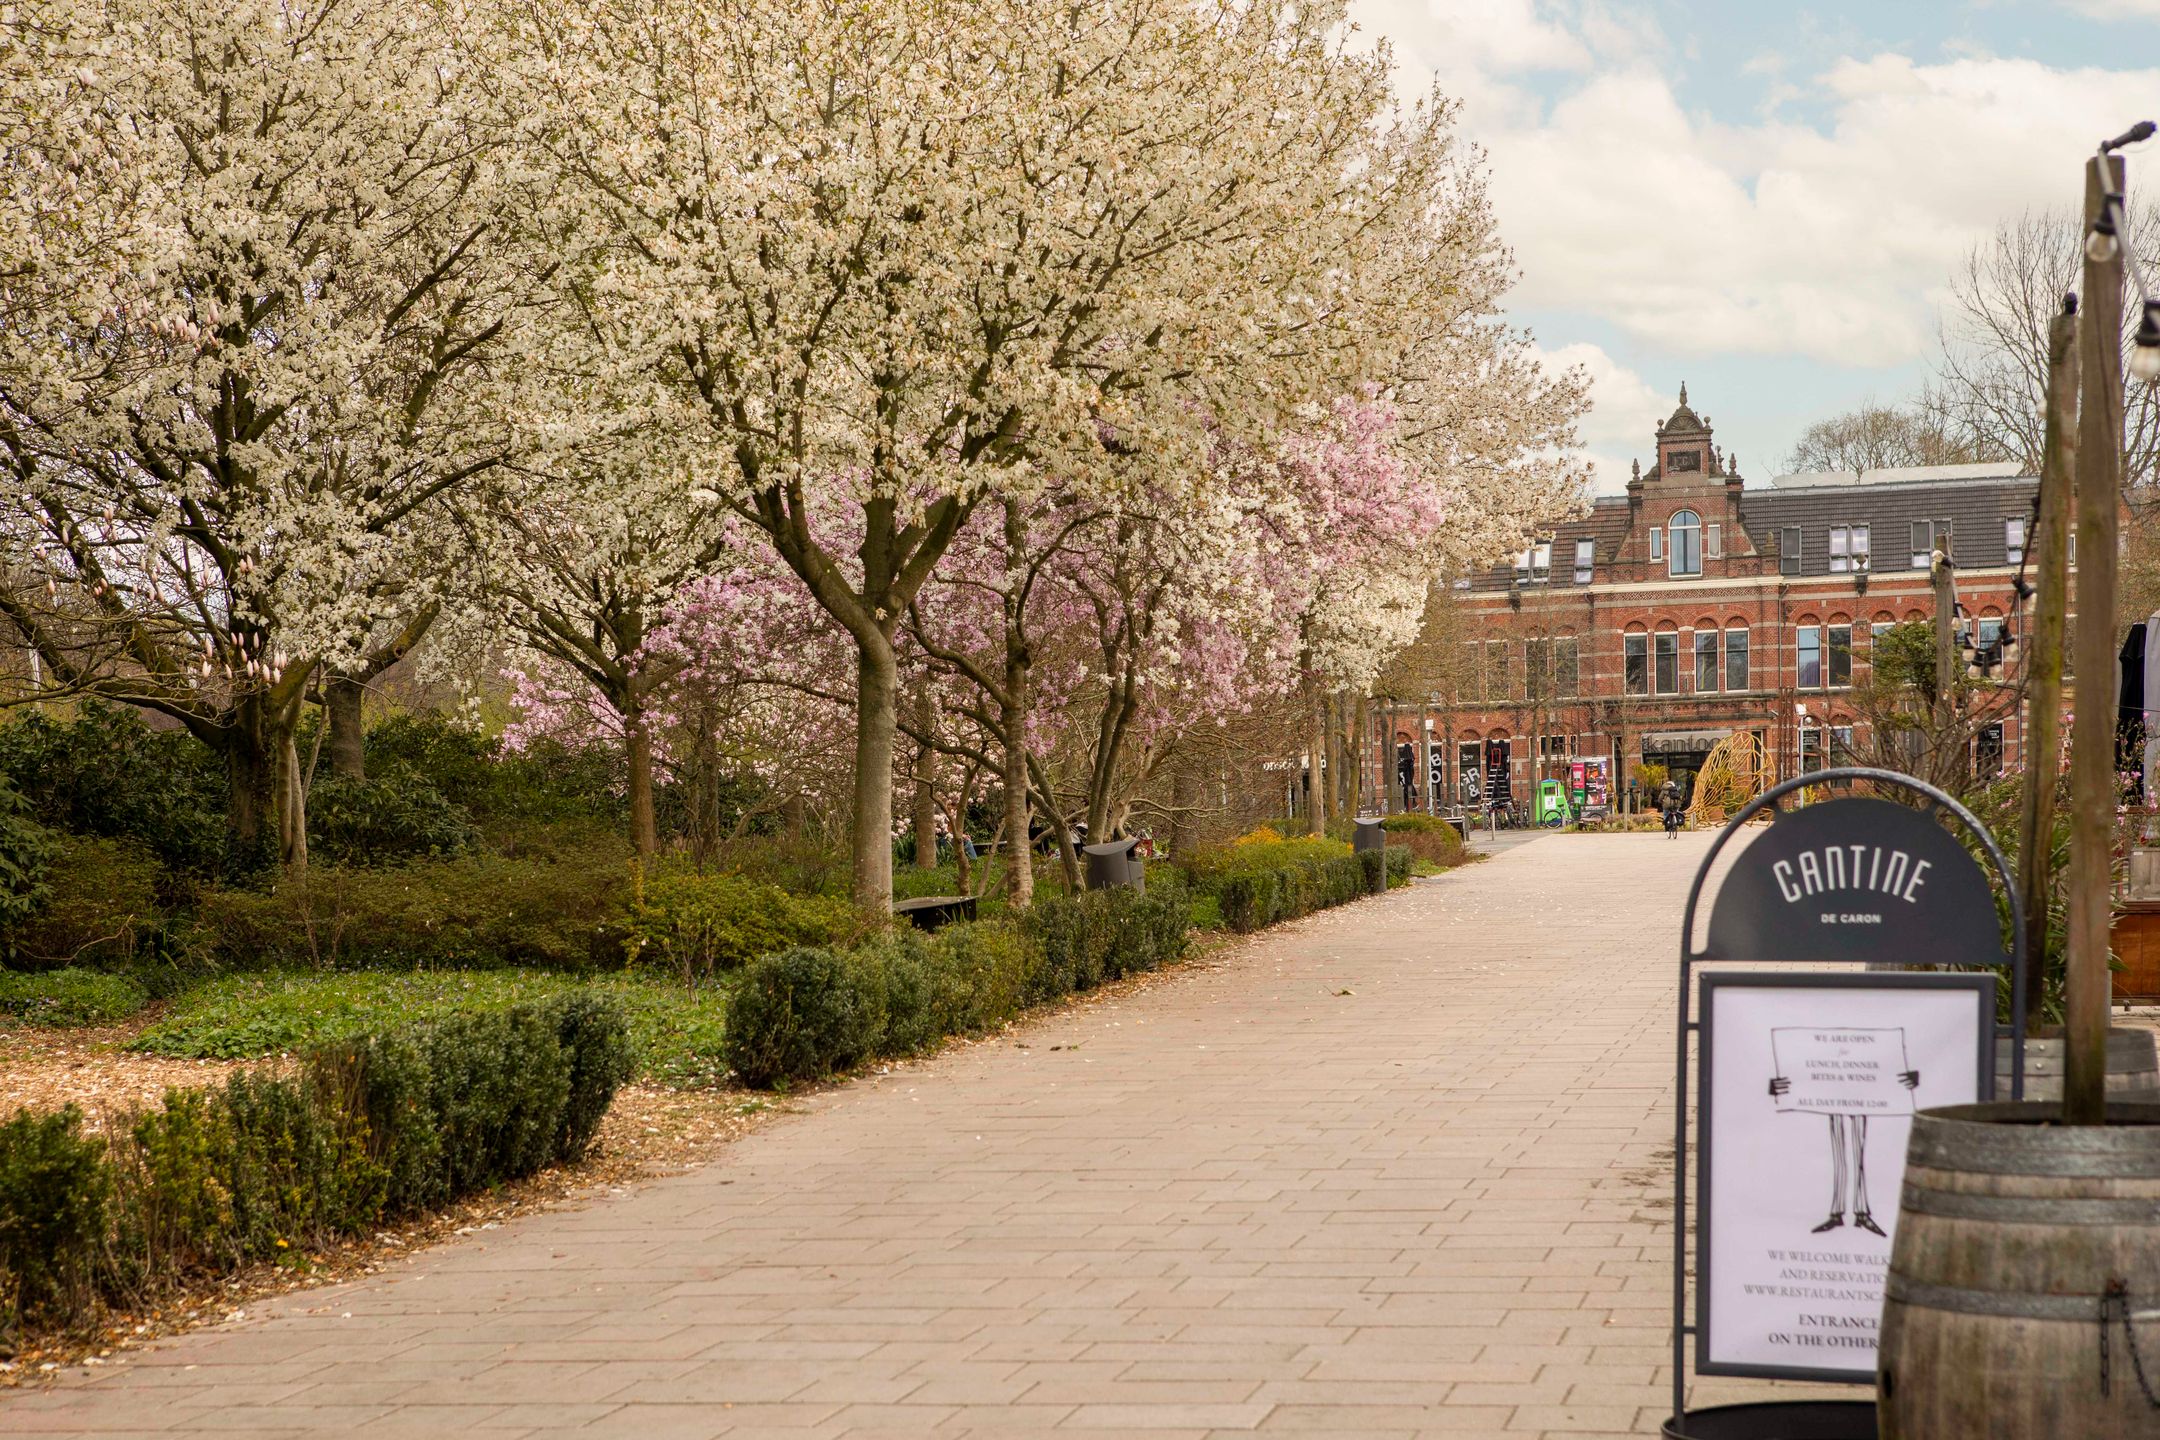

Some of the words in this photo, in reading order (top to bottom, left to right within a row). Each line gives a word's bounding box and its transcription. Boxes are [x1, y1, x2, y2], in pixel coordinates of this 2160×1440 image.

[1648, 734, 1722, 753] kantoo
[1772, 845, 1932, 903] CANTINE
[1820, 913, 1837, 924] DE
[1840, 913, 1882, 924] CARON
[1814, 1034, 1828, 1043] WE
[1831, 1034, 1848, 1043] ARE
[1849, 1034, 1876, 1043] OPEN
[1842, 1060, 1879, 1069] DINNER
[1811, 1073, 1836, 1081] BITES
[1847, 1073, 1876, 1082] WINES
[1797, 1098, 1814, 1107] ALL
[1816, 1098, 1836, 1107] DAY
[1837, 1099, 1864, 1108] FROM
[1767, 1249, 1786, 1261] WE
[1788, 1250, 1852, 1264] WELCOME
[1779, 1268, 1808, 1280] AND
[1743, 1284, 1885, 1301] WWW.RESTAURANTSC
[1799, 1313, 1880, 1329] ENTRANCE
[1767, 1332, 1790, 1344] ON
[1794, 1333, 1824, 1347] THE
[1826, 1335, 1880, 1349] OTHER
